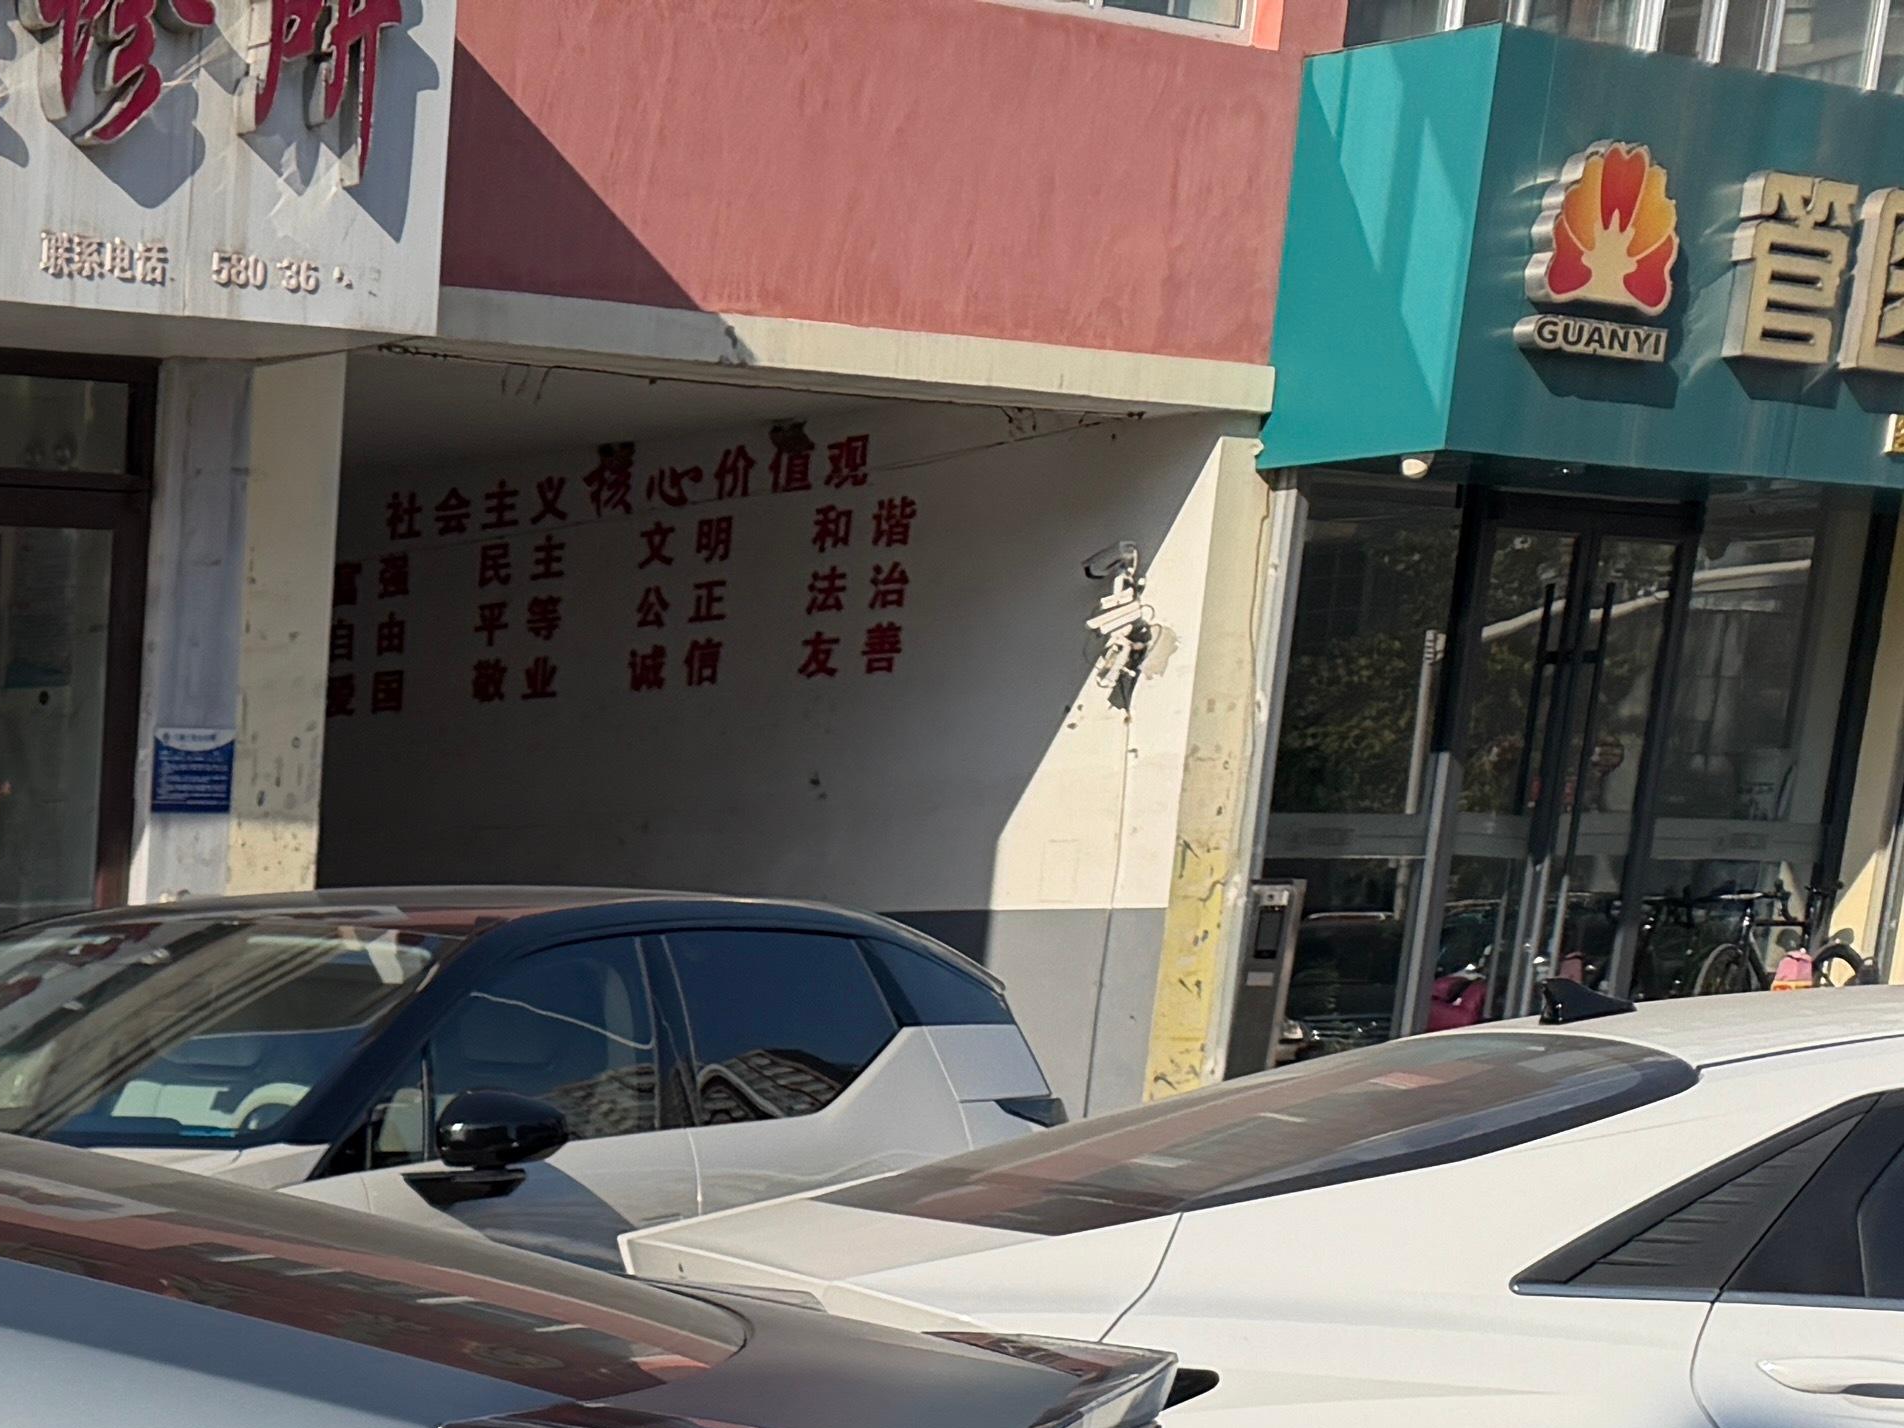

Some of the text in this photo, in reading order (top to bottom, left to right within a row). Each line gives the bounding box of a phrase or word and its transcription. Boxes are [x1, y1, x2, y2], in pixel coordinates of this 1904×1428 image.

[39, 231, 169, 287] 联系电话
[1535, 317, 1666, 359] GUANYI
[386, 434, 870, 540] 社会主义核心价值观
[477, 534, 566, 588] 民主
[639, 515, 733, 569] 文明
[812, 496, 917, 551] 和谐
[330, 563, 911, 661] 自由 平等 公正 法治
[472, 656, 558, 704] 敬业
[628, 639, 724, 693] 诚信
[797, 623, 904, 678] 友善
